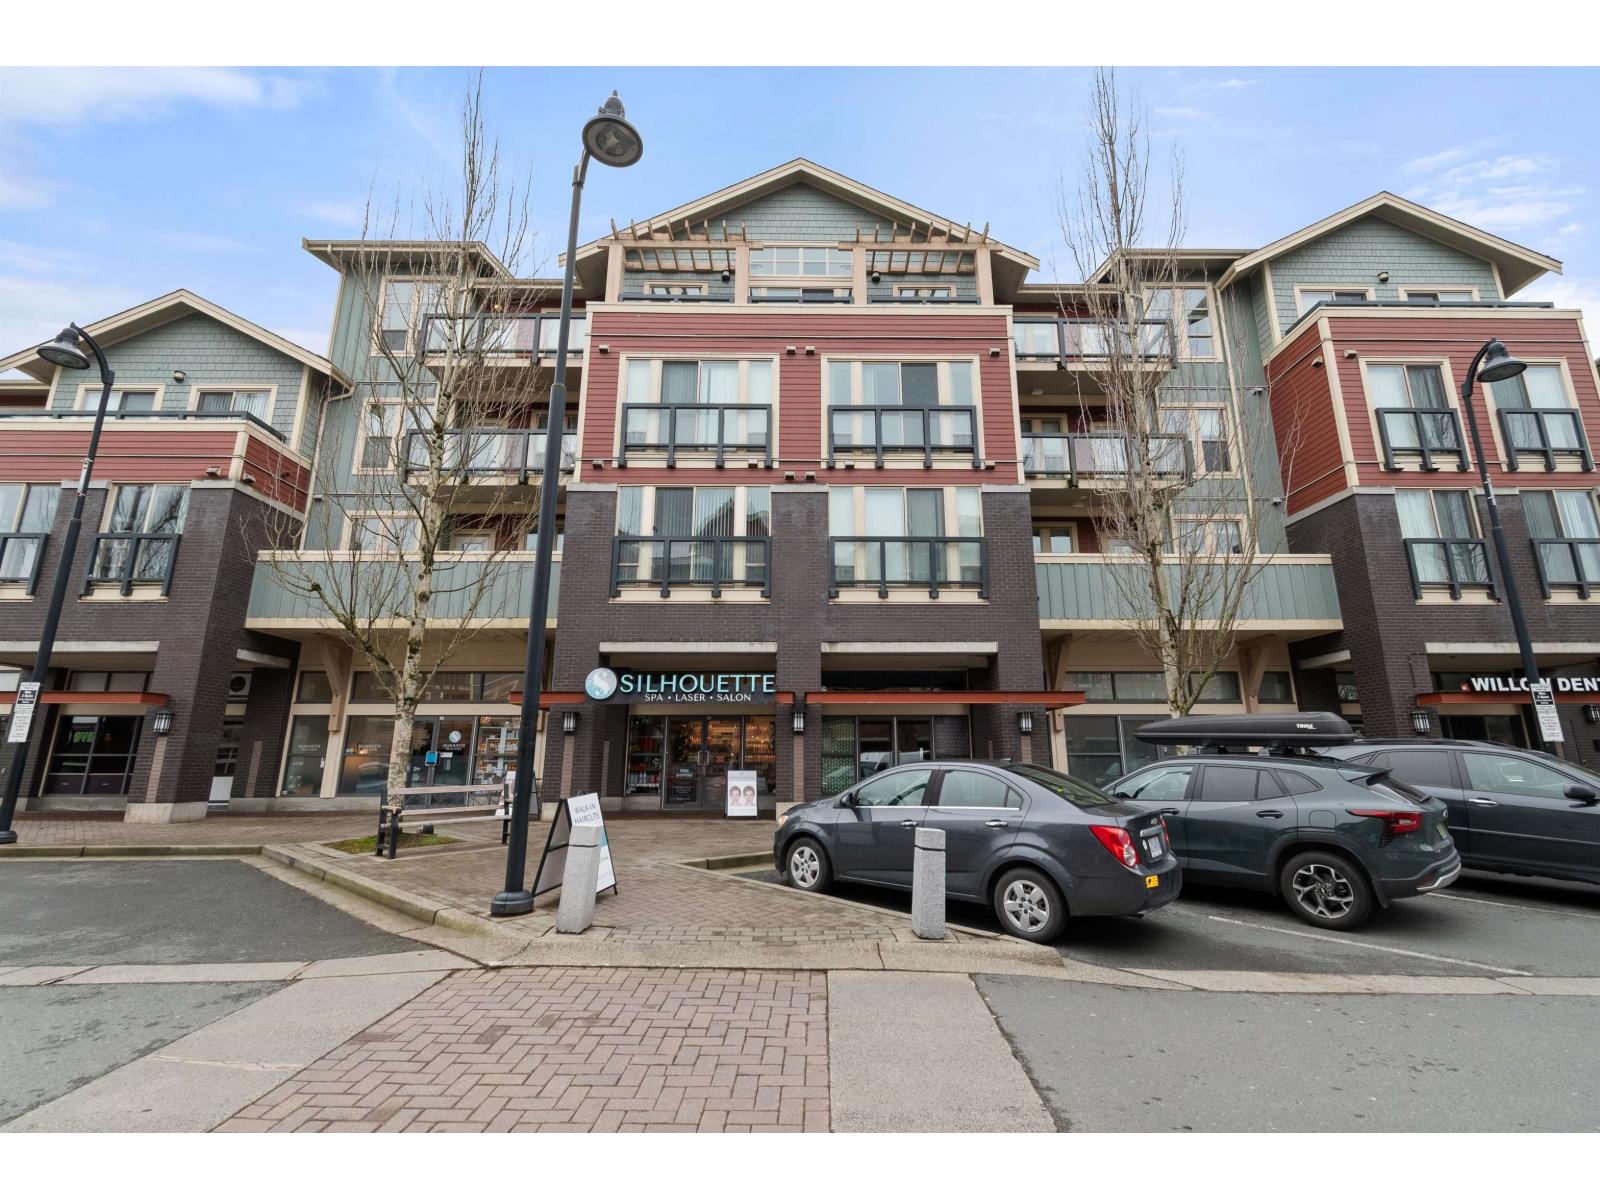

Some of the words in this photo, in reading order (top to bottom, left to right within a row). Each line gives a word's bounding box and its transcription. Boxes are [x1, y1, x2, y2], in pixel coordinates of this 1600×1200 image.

[620, 674, 775, 693] SILHOUETTE
[645, 694, 663, 702] SPA
[675, 694, 706, 702] LASER
[717, 694, 751, 702] SALON
